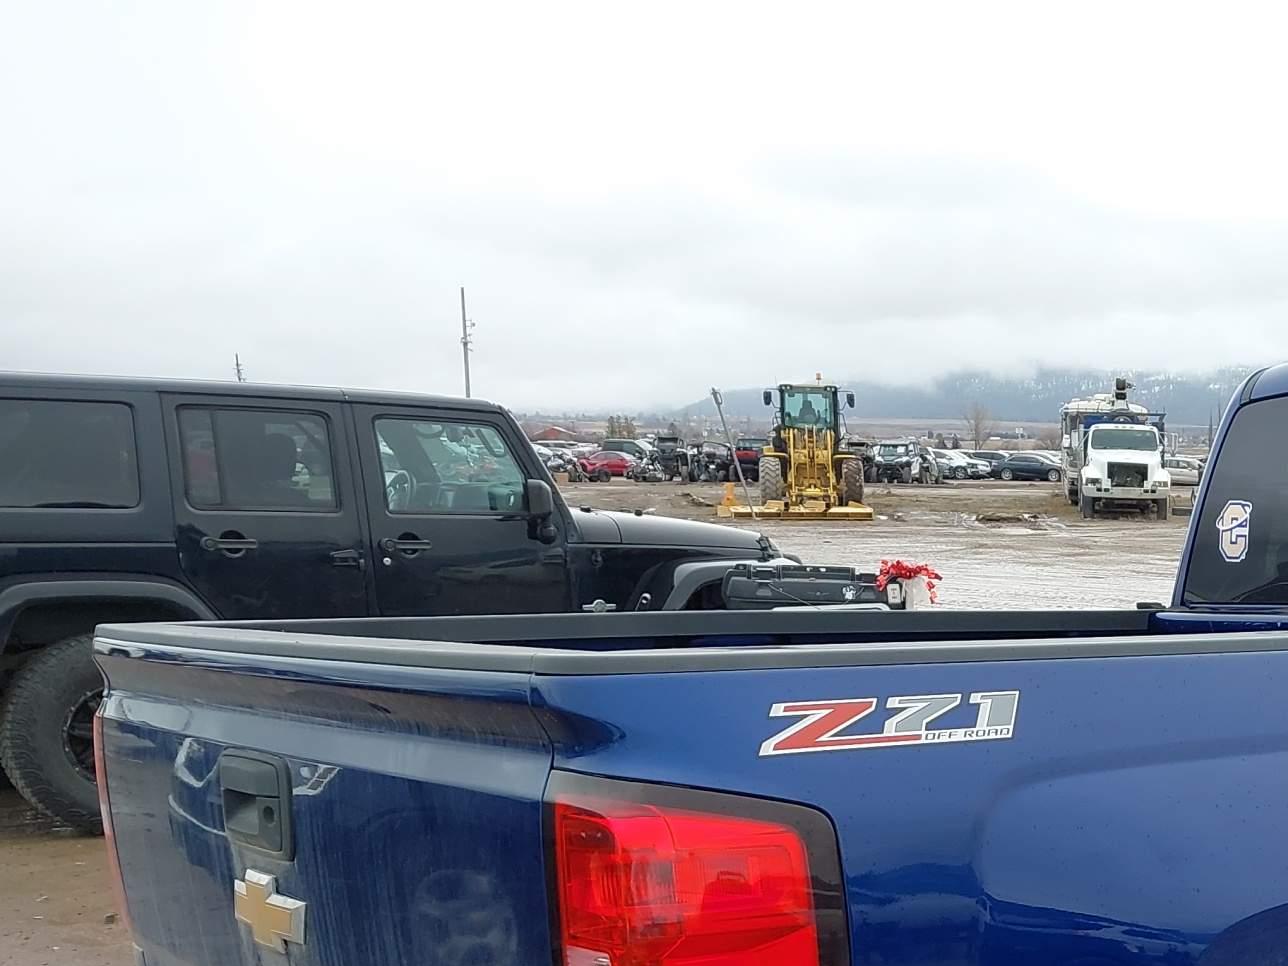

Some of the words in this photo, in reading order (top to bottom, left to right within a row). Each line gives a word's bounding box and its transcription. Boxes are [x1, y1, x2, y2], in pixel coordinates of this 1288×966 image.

[759, 691, 1019, 756] Z71
[924, 730, 955, 742] OFF
[963, 727, 1011, 739] ROAD
